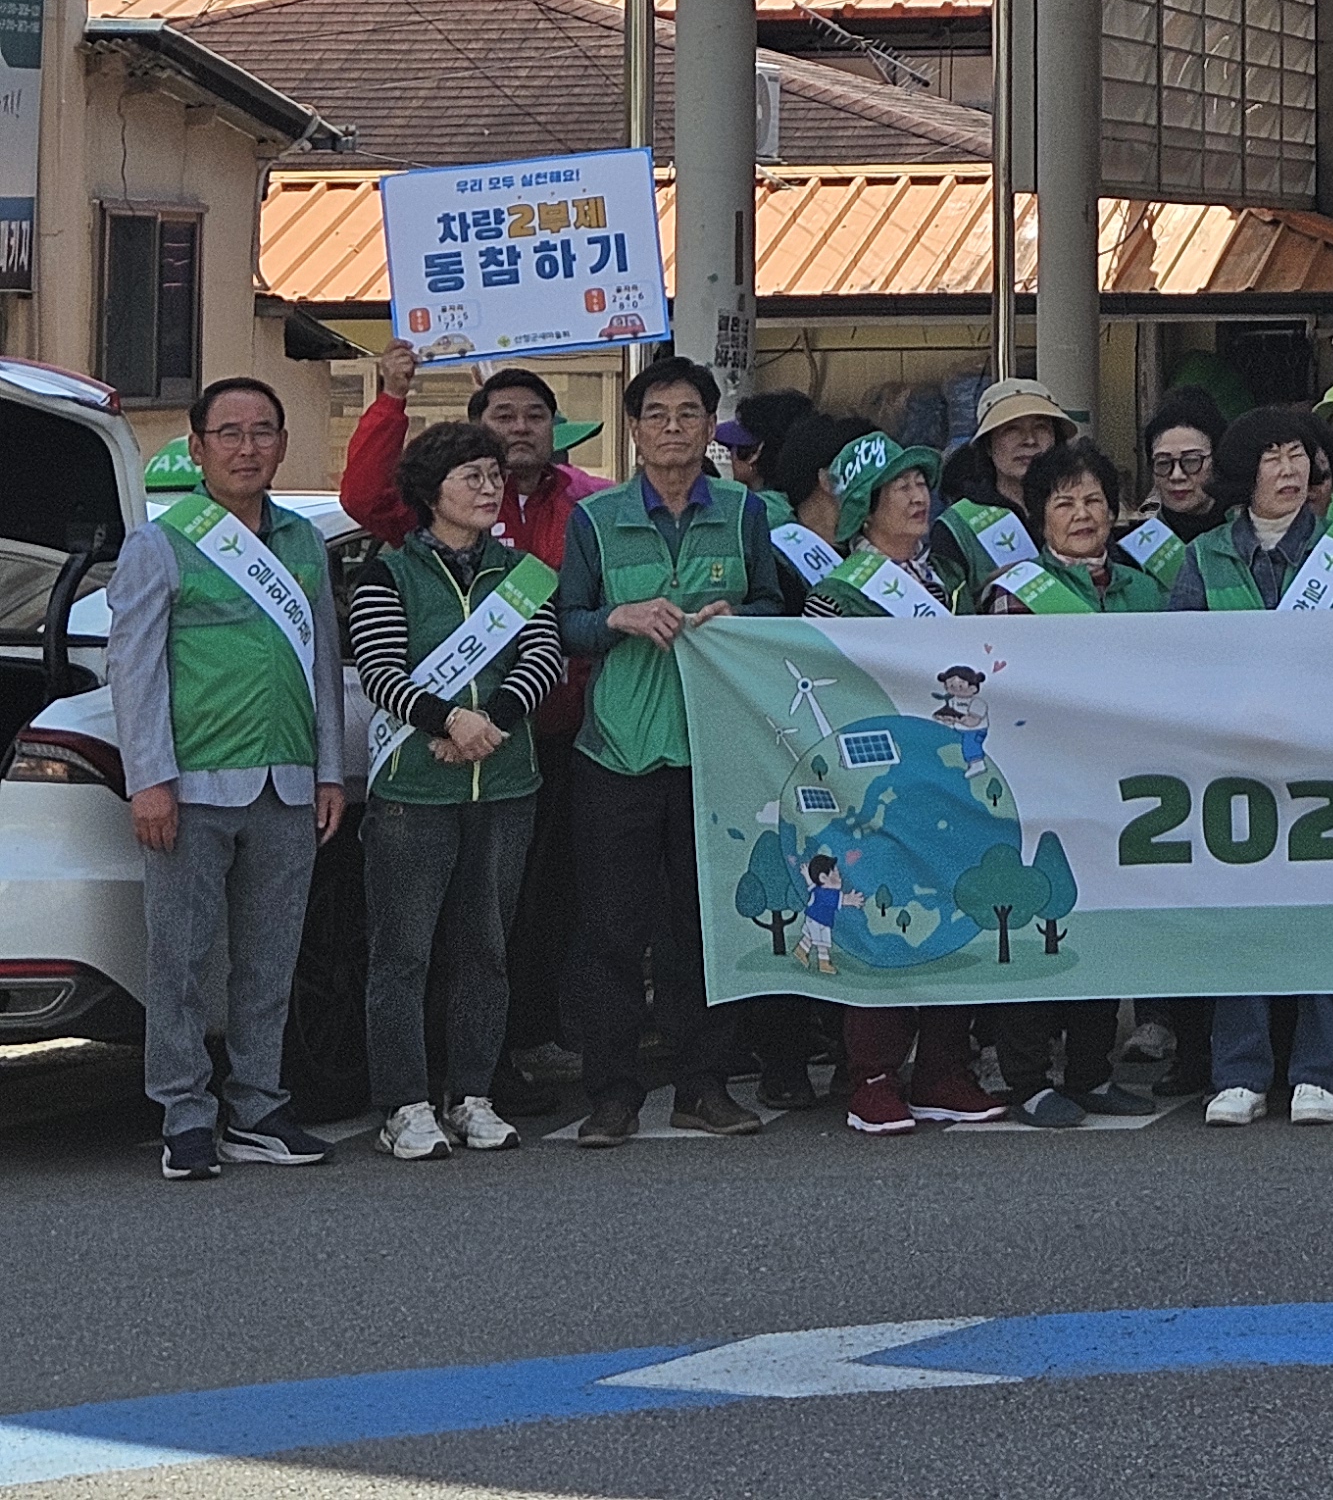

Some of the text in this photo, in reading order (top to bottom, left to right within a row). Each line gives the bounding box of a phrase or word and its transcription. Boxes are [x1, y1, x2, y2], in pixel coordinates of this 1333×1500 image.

[456, 168, 581, 194] 우리 모두 실천해요!
[424, 232, 629, 294] 동참하기
[144, 453, 203, 474] TAX
